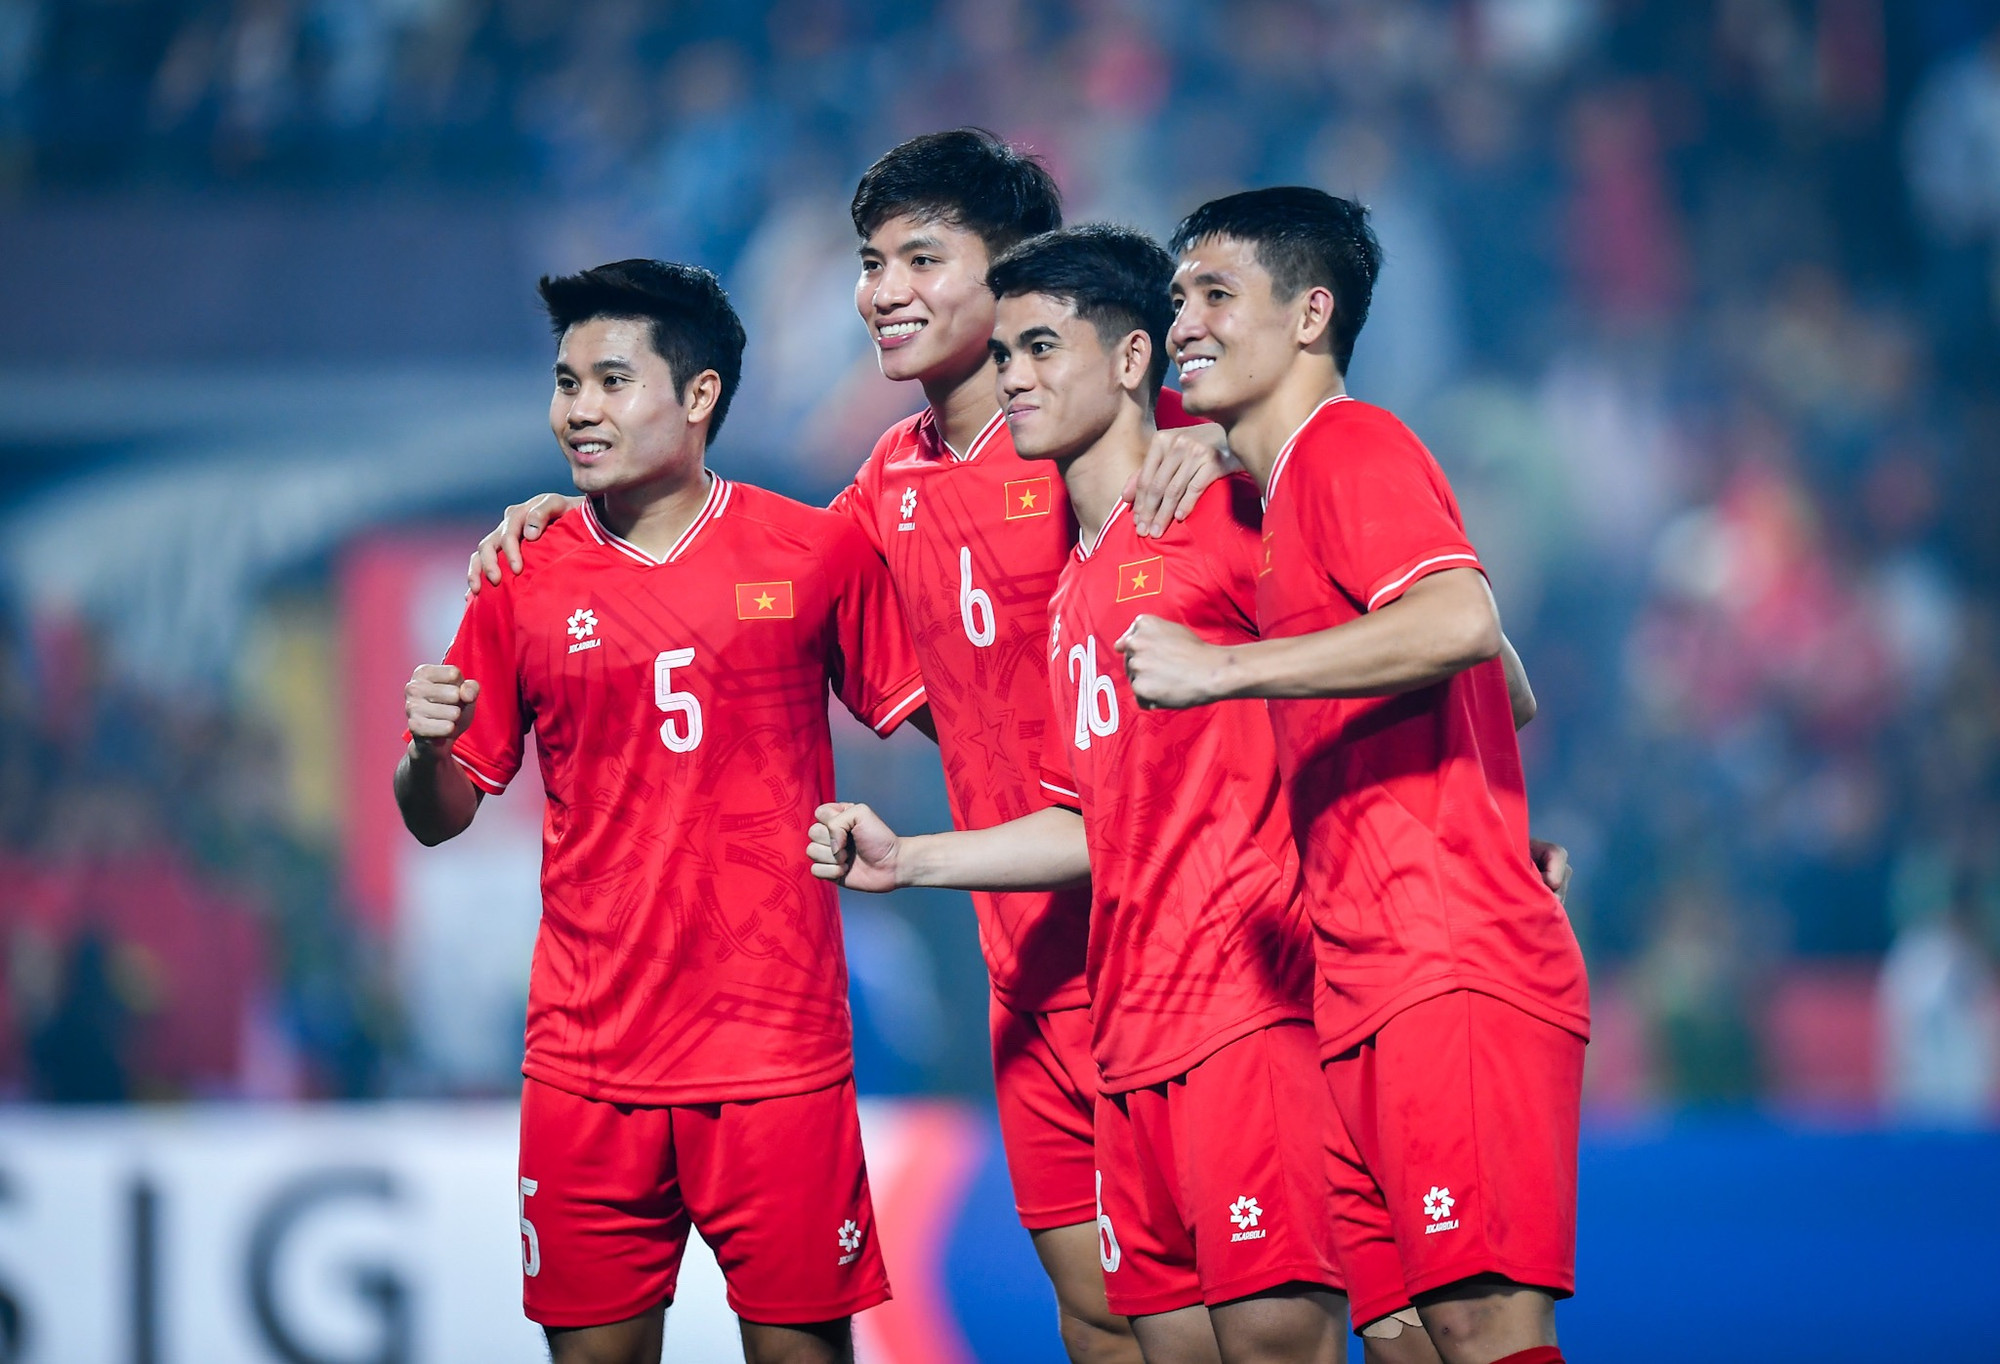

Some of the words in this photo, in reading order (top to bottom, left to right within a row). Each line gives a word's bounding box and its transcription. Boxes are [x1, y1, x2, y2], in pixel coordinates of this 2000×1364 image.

[960, 546, 996, 647] 6
[654, 647, 703, 753] 5
[1068, 634, 1119, 751] 26
[0, 1164, 418, 1364] IG
[519, 1176, 541, 1277] 5
